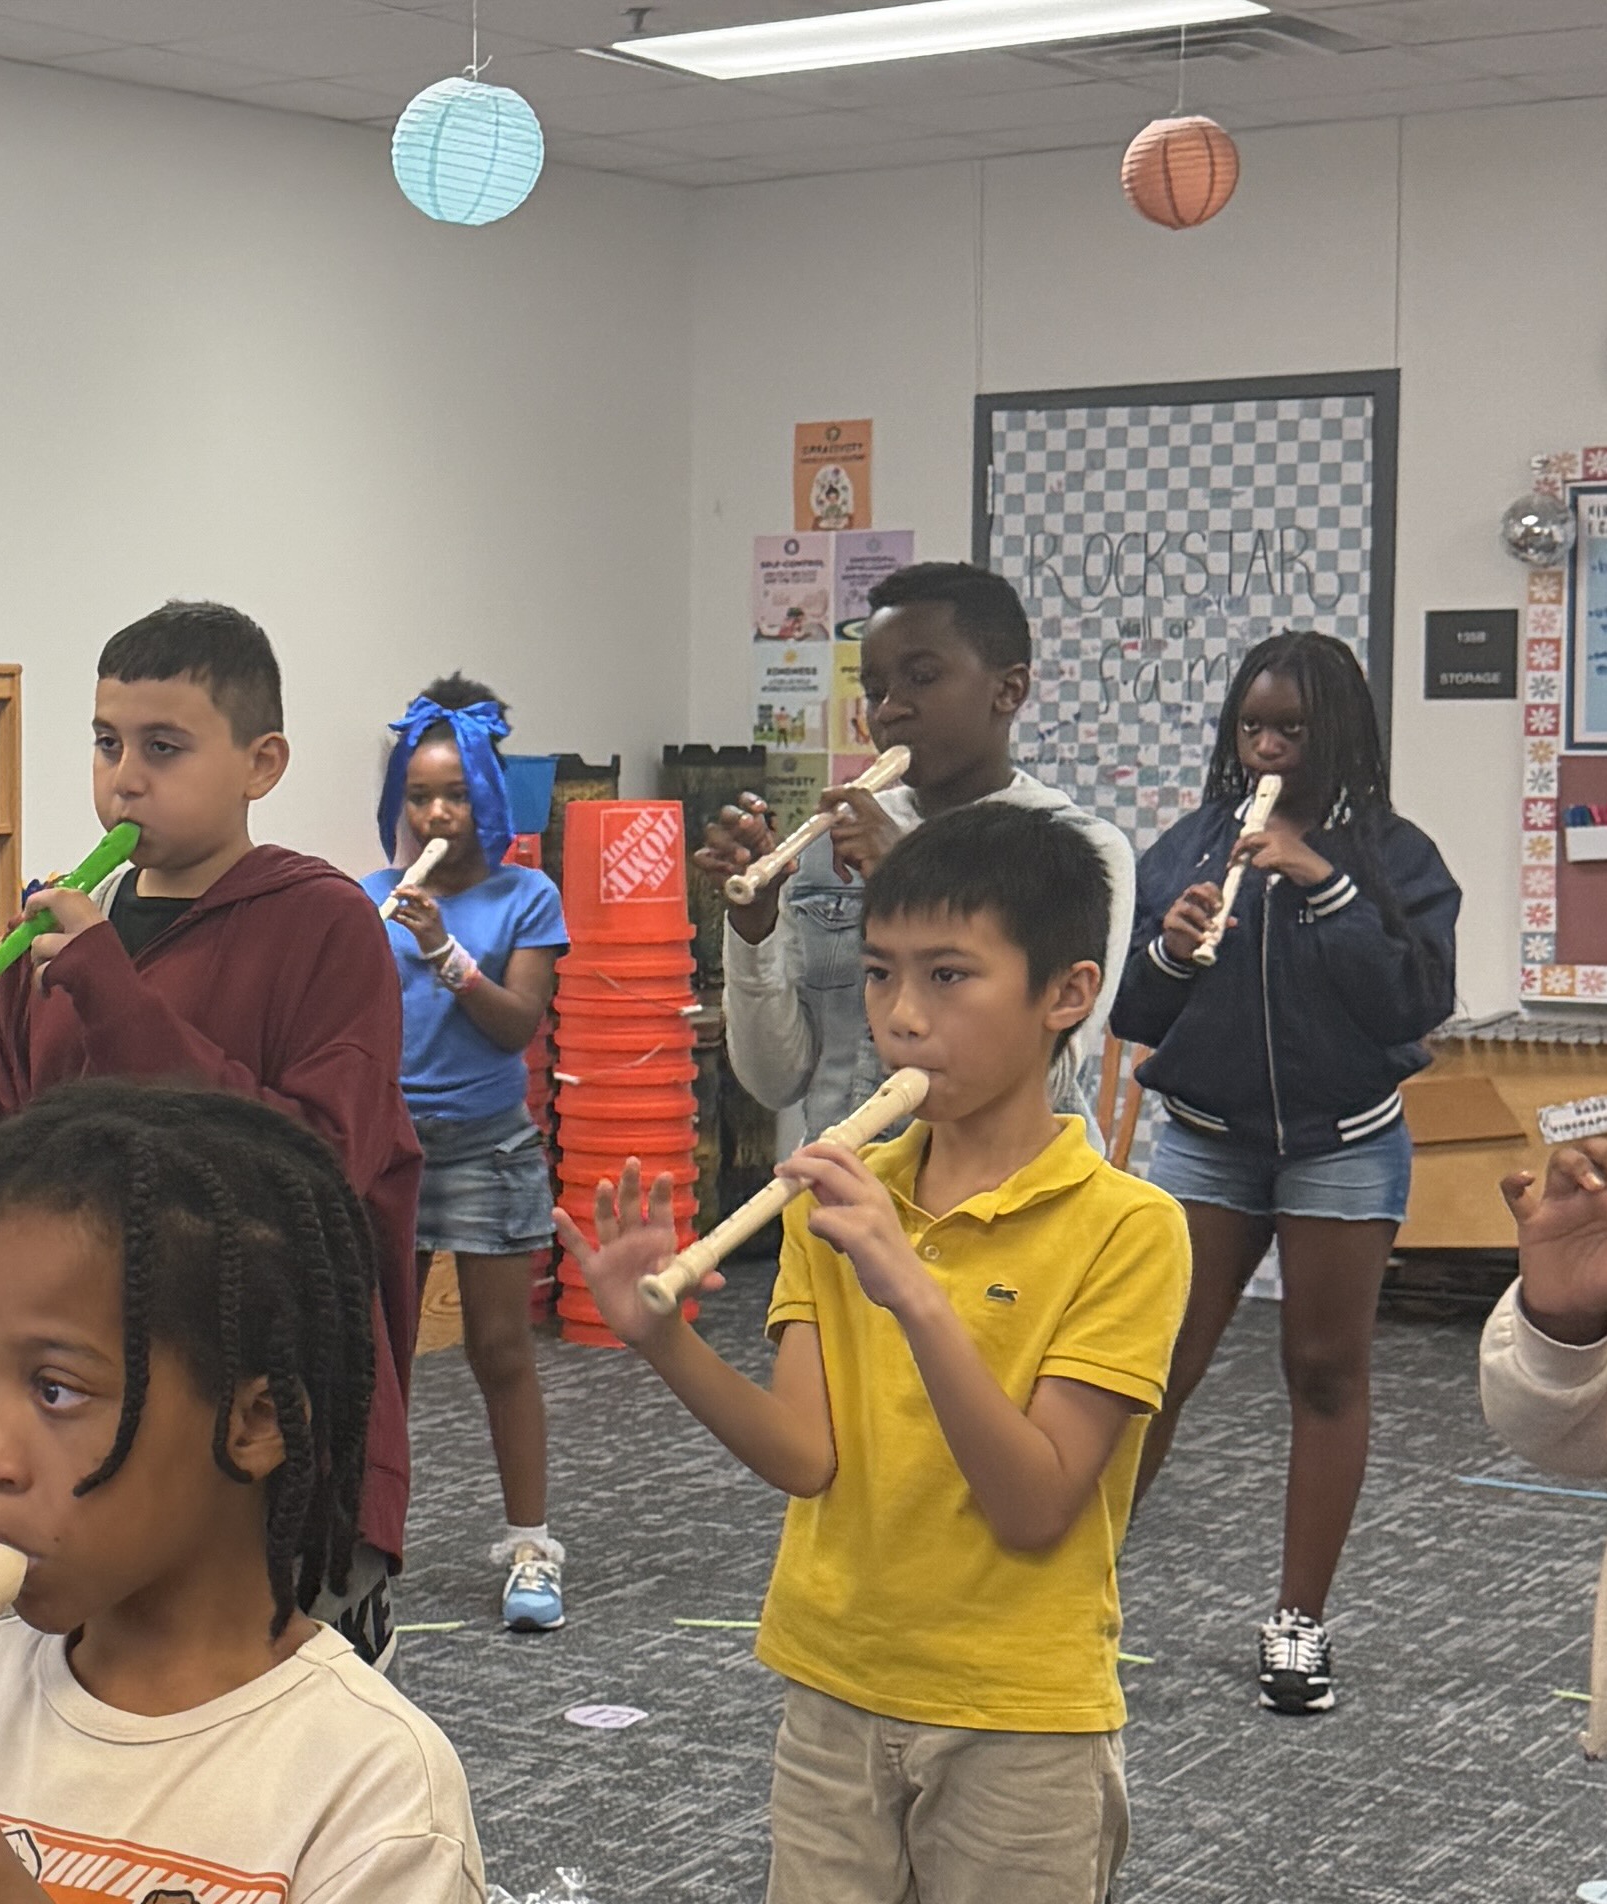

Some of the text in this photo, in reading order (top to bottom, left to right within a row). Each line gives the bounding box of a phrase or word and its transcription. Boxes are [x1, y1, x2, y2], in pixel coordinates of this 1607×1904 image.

[1029, 525, 1342, 611] ROCKSTAR
[1439, 671, 1501, 686] STORAGE
[606, 809, 679, 901] HOME
